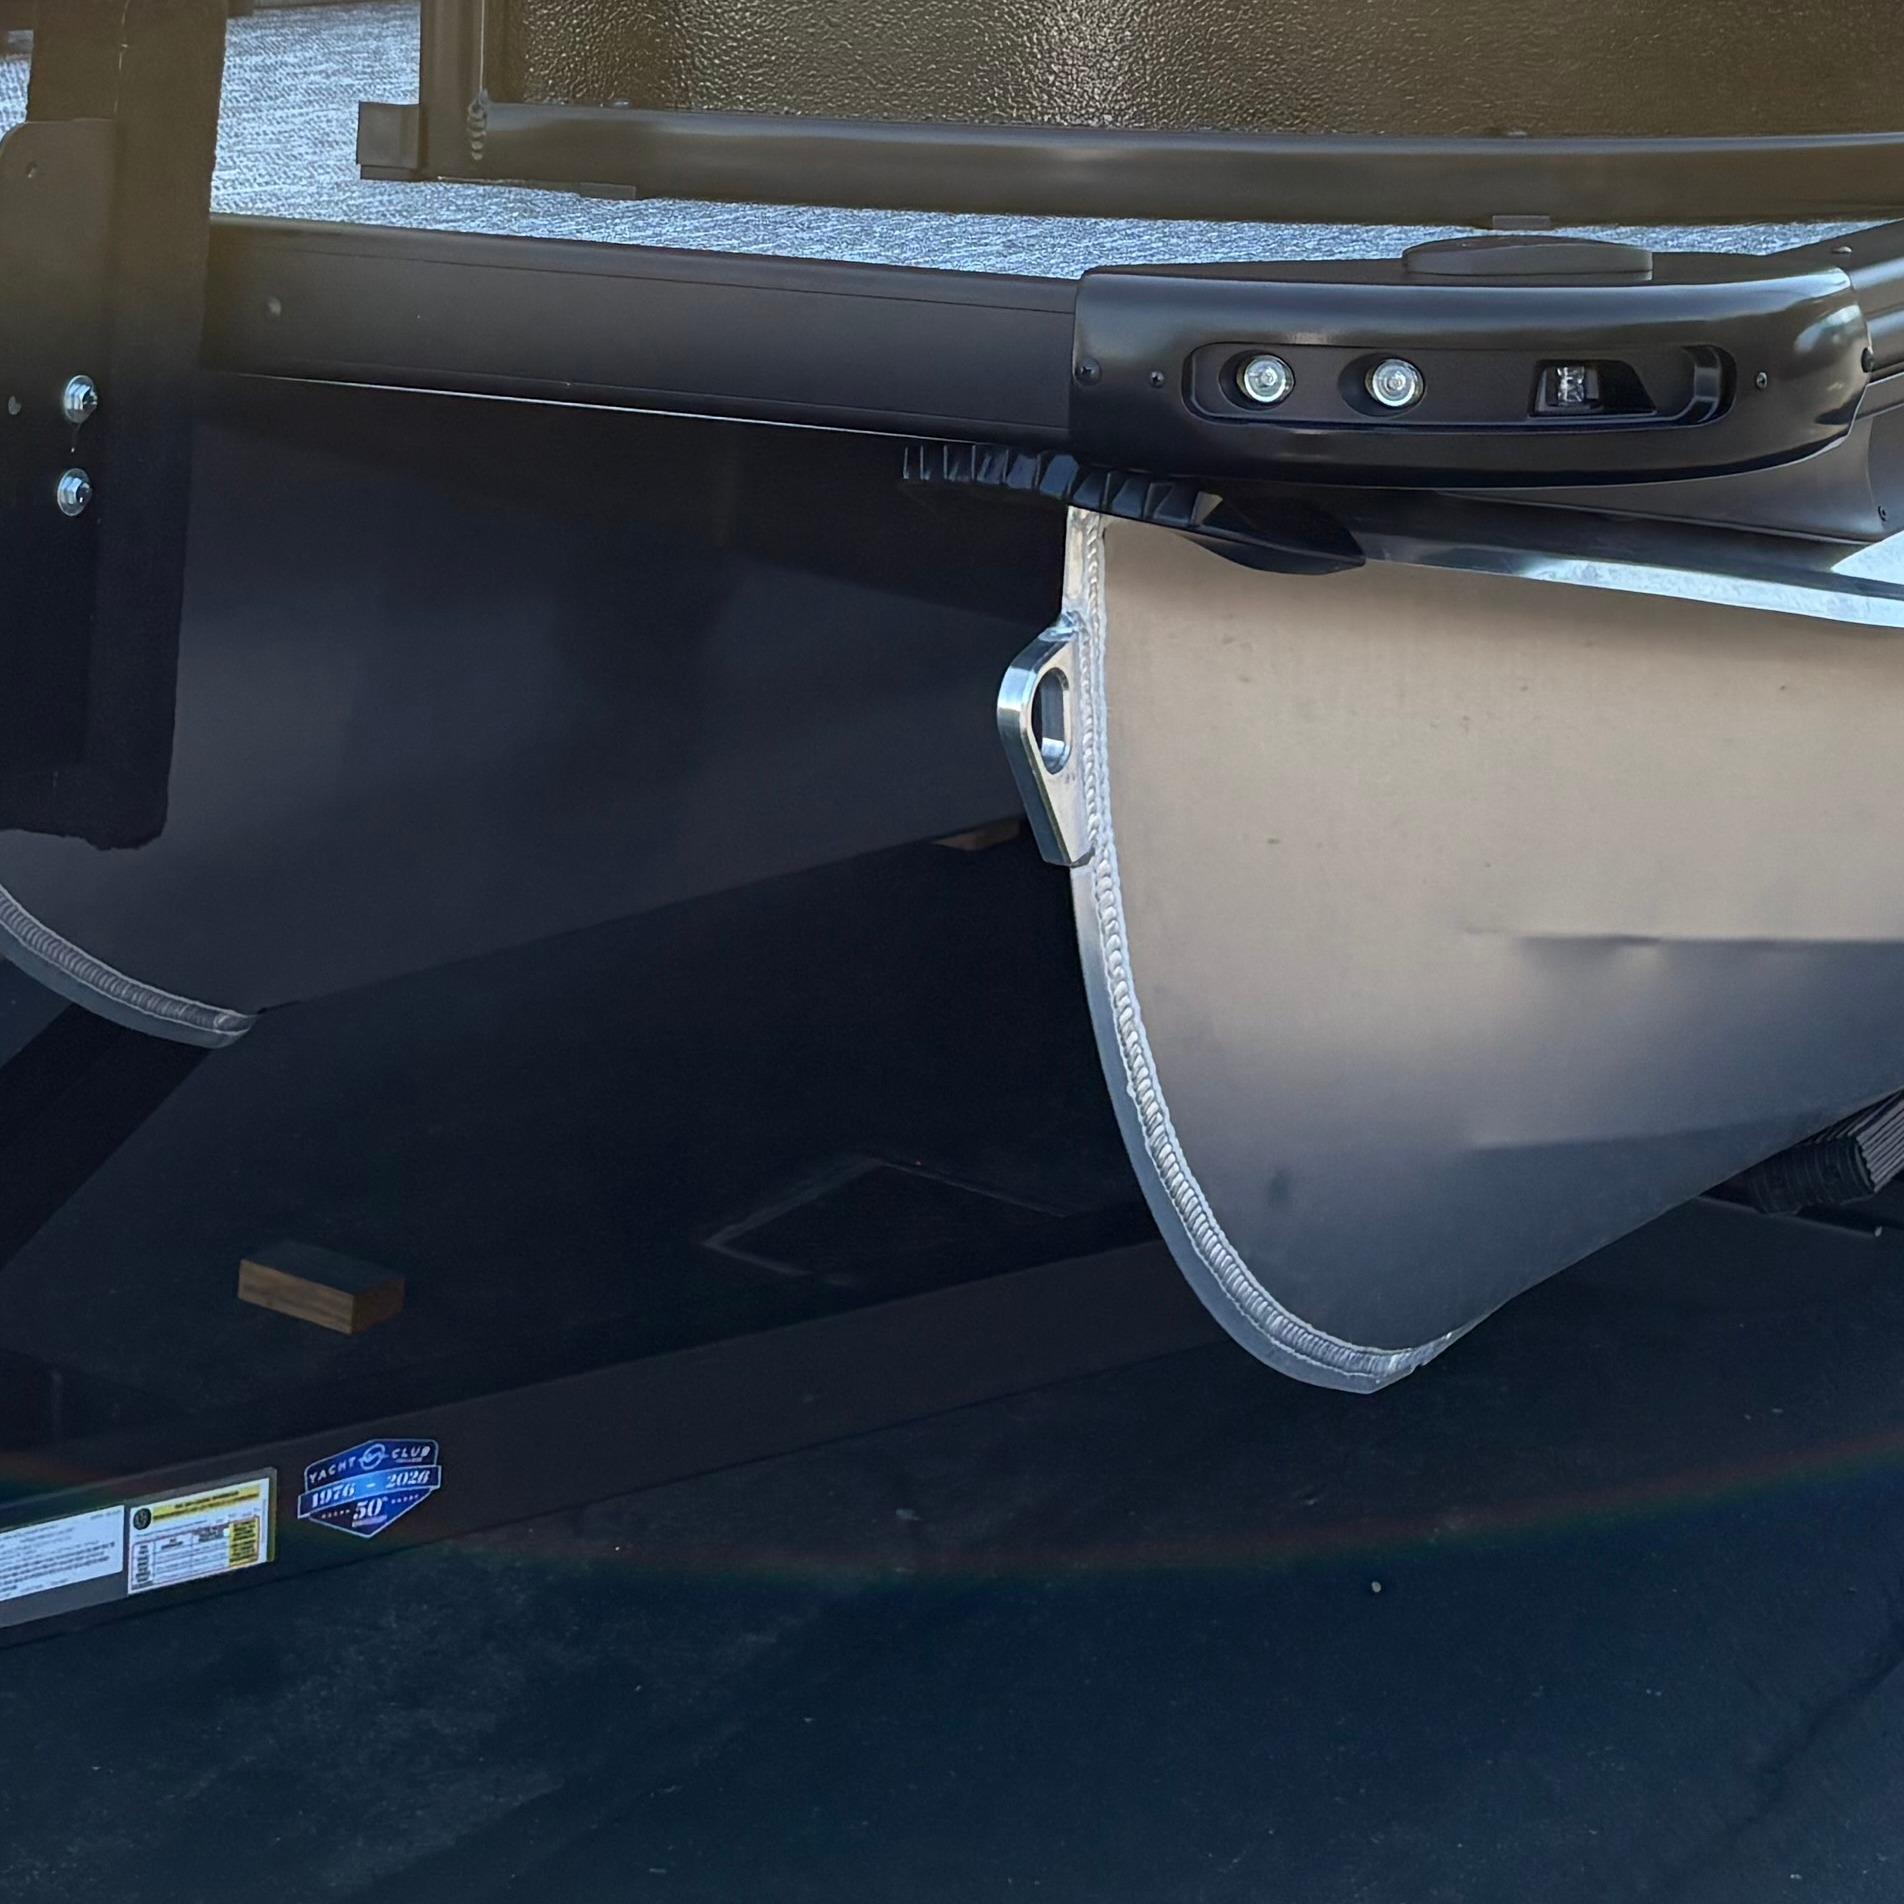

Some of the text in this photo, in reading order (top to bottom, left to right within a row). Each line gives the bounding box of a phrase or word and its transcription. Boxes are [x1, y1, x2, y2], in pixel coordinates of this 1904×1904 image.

[308, 1445, 431, 1484] YACHT CLUB
[311, 1482, 357, 1509] 1976
